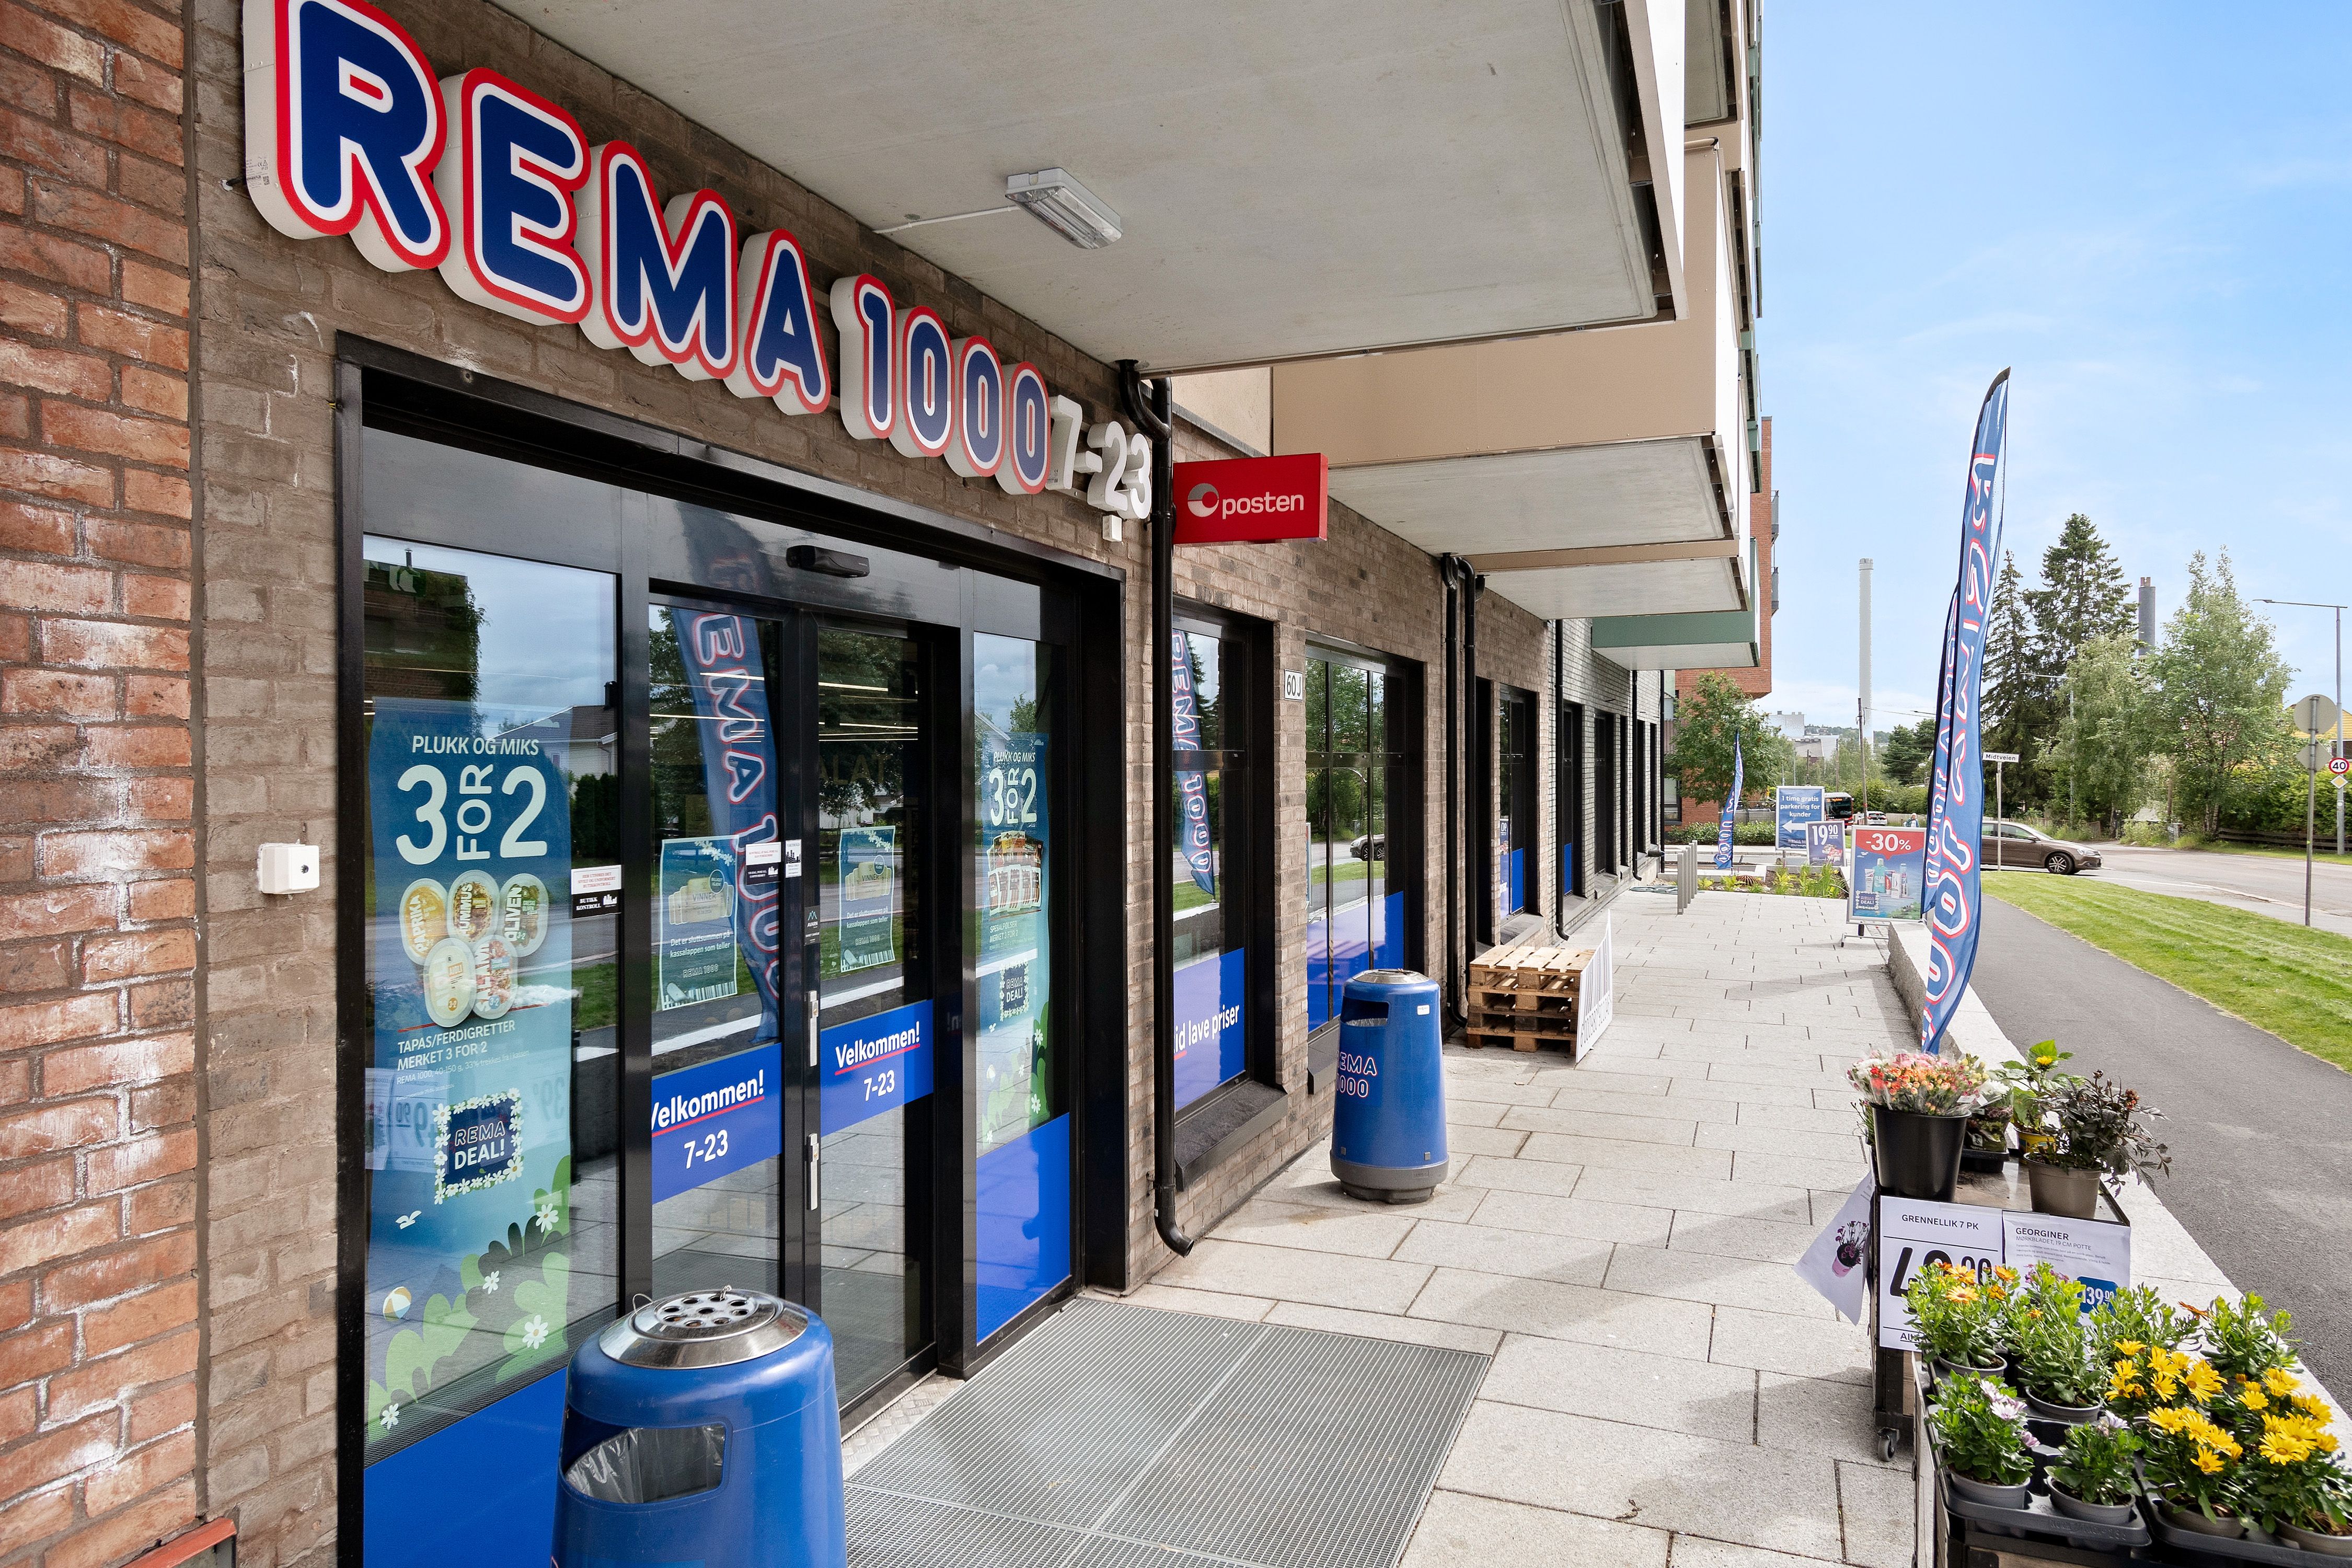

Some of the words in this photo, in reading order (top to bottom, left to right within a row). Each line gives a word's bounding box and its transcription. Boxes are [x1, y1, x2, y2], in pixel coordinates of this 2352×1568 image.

[275, 0, 831, 414] REMA
[854, 273, 1051, 495] 1000
[1051, 394, 1151, 520] 7-23
[1222, 491, 1304, 519] posten
[412, 735, 469, 754] PLUKK
[472, 737, 495, 755] OG
[500, 739, 539, 755] MIKS
[994, 751, 1012, 763] PLUKK
[1012, 752, 1021, 763] OG
[1022, 751, 1035, 762] MIKS
[1986, 753, 2016, 762] Midtveien
[2332, 761, 2346, 770] 40
[989, 767, 1004, 826] 3
[1007, 767, 1019, 824] FOR
[1021, 767, 1037, 823] 2
[396, 765, 447, 864] 3
[457, 764, 493, 861] FOR
[500, 766, 547, 858] 2
[1812, 825, 1828, 846] 19
[1828, 825, 1838, 835] 90
[1866, 833, 1911, 851] -30%
[693, 892, 717, 902] VINNER
[409, 894, 428, 953] PAPRIKA
[504, 887, 522, 942] OLIVEN
[671, 938, 681, 947] Det
[688, 931, 722, 944] sluttsummen
[723, 930, 730, 939] på
[670, 945, 704, 958] kassalappen
[717, 941, 731, 950] teller
[683, 966, 703, 978] REMA
[703, 963, 719, 974] 1000
[1006, 977, 1023, 991] REMA
[1006, 987, 1023, 1004] DEAL!
[398, 1020, 515, 1054] TAPAS/FERDIGRETTER
[1174, 1020, 1186, 1053] id
[1188, 1020, 1209, 1047] lave
[1211, 1004, 1239, 1041] priser
[835, 1021, 920, 1069] Velkommen!
[398, 1050, 444, 1071] MERKET
[445, 1047, 453, 1060] 3
[455, 1044, 477, 1058] FOR
[481, 1041, 488, 1053] 2
[397, 1075, 416, 1085] REMA
[418, 1070, 433, 1080] 1000,
[864, 1070, 895, 1102] 7-23
[454, 1121, 506, 1147] REMA
[454, 1138, 505, 1170] DEAL!
[684, 1129, 729, 1169] 7-23
[1901, 1214, 1958, 1228] GRENNELLIK
[1966, 1221, 1979, 1230] PK
[2016, 1227, 2069, 1241] GEORGINER
[2016, 1236, 2054, 1245] MØRKBLADET,
